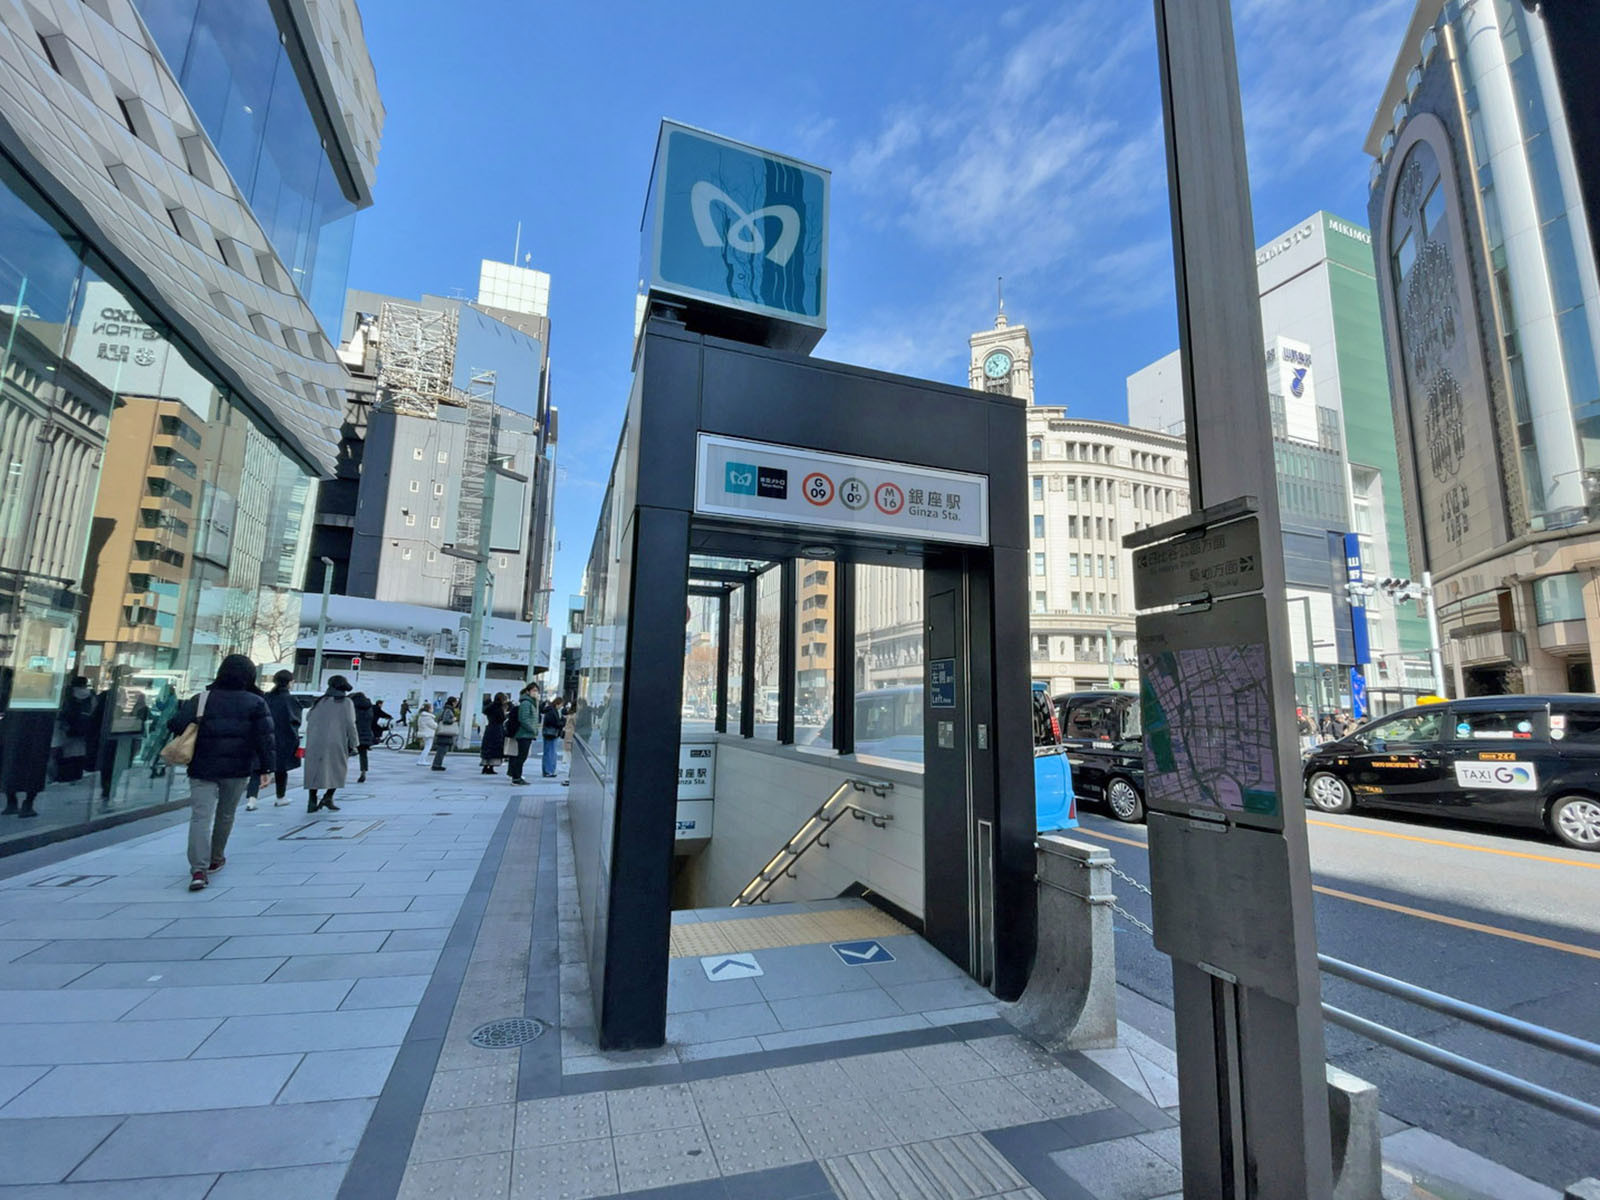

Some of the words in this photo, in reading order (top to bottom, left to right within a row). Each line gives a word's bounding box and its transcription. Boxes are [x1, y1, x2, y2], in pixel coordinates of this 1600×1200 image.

[1329, 219, 1371, 244] MIKIMO
[1256, 224, 1315, 265] KIMOTO
[814, 478, 823, 487] G
[851, 483, 859, 493] H
[810, 488, 826, 499] 09
[847, 492, 862, 503] 09
[884, 488, 895, 497] M
[882, 497, 897, 508] 16
[908, 489, 961, 510] 銀座駅
[908, 505, 938, 518] Ginza
[942, 509, 961, 521] Sta.
[1462, 769, 1491, 779] TAXI
